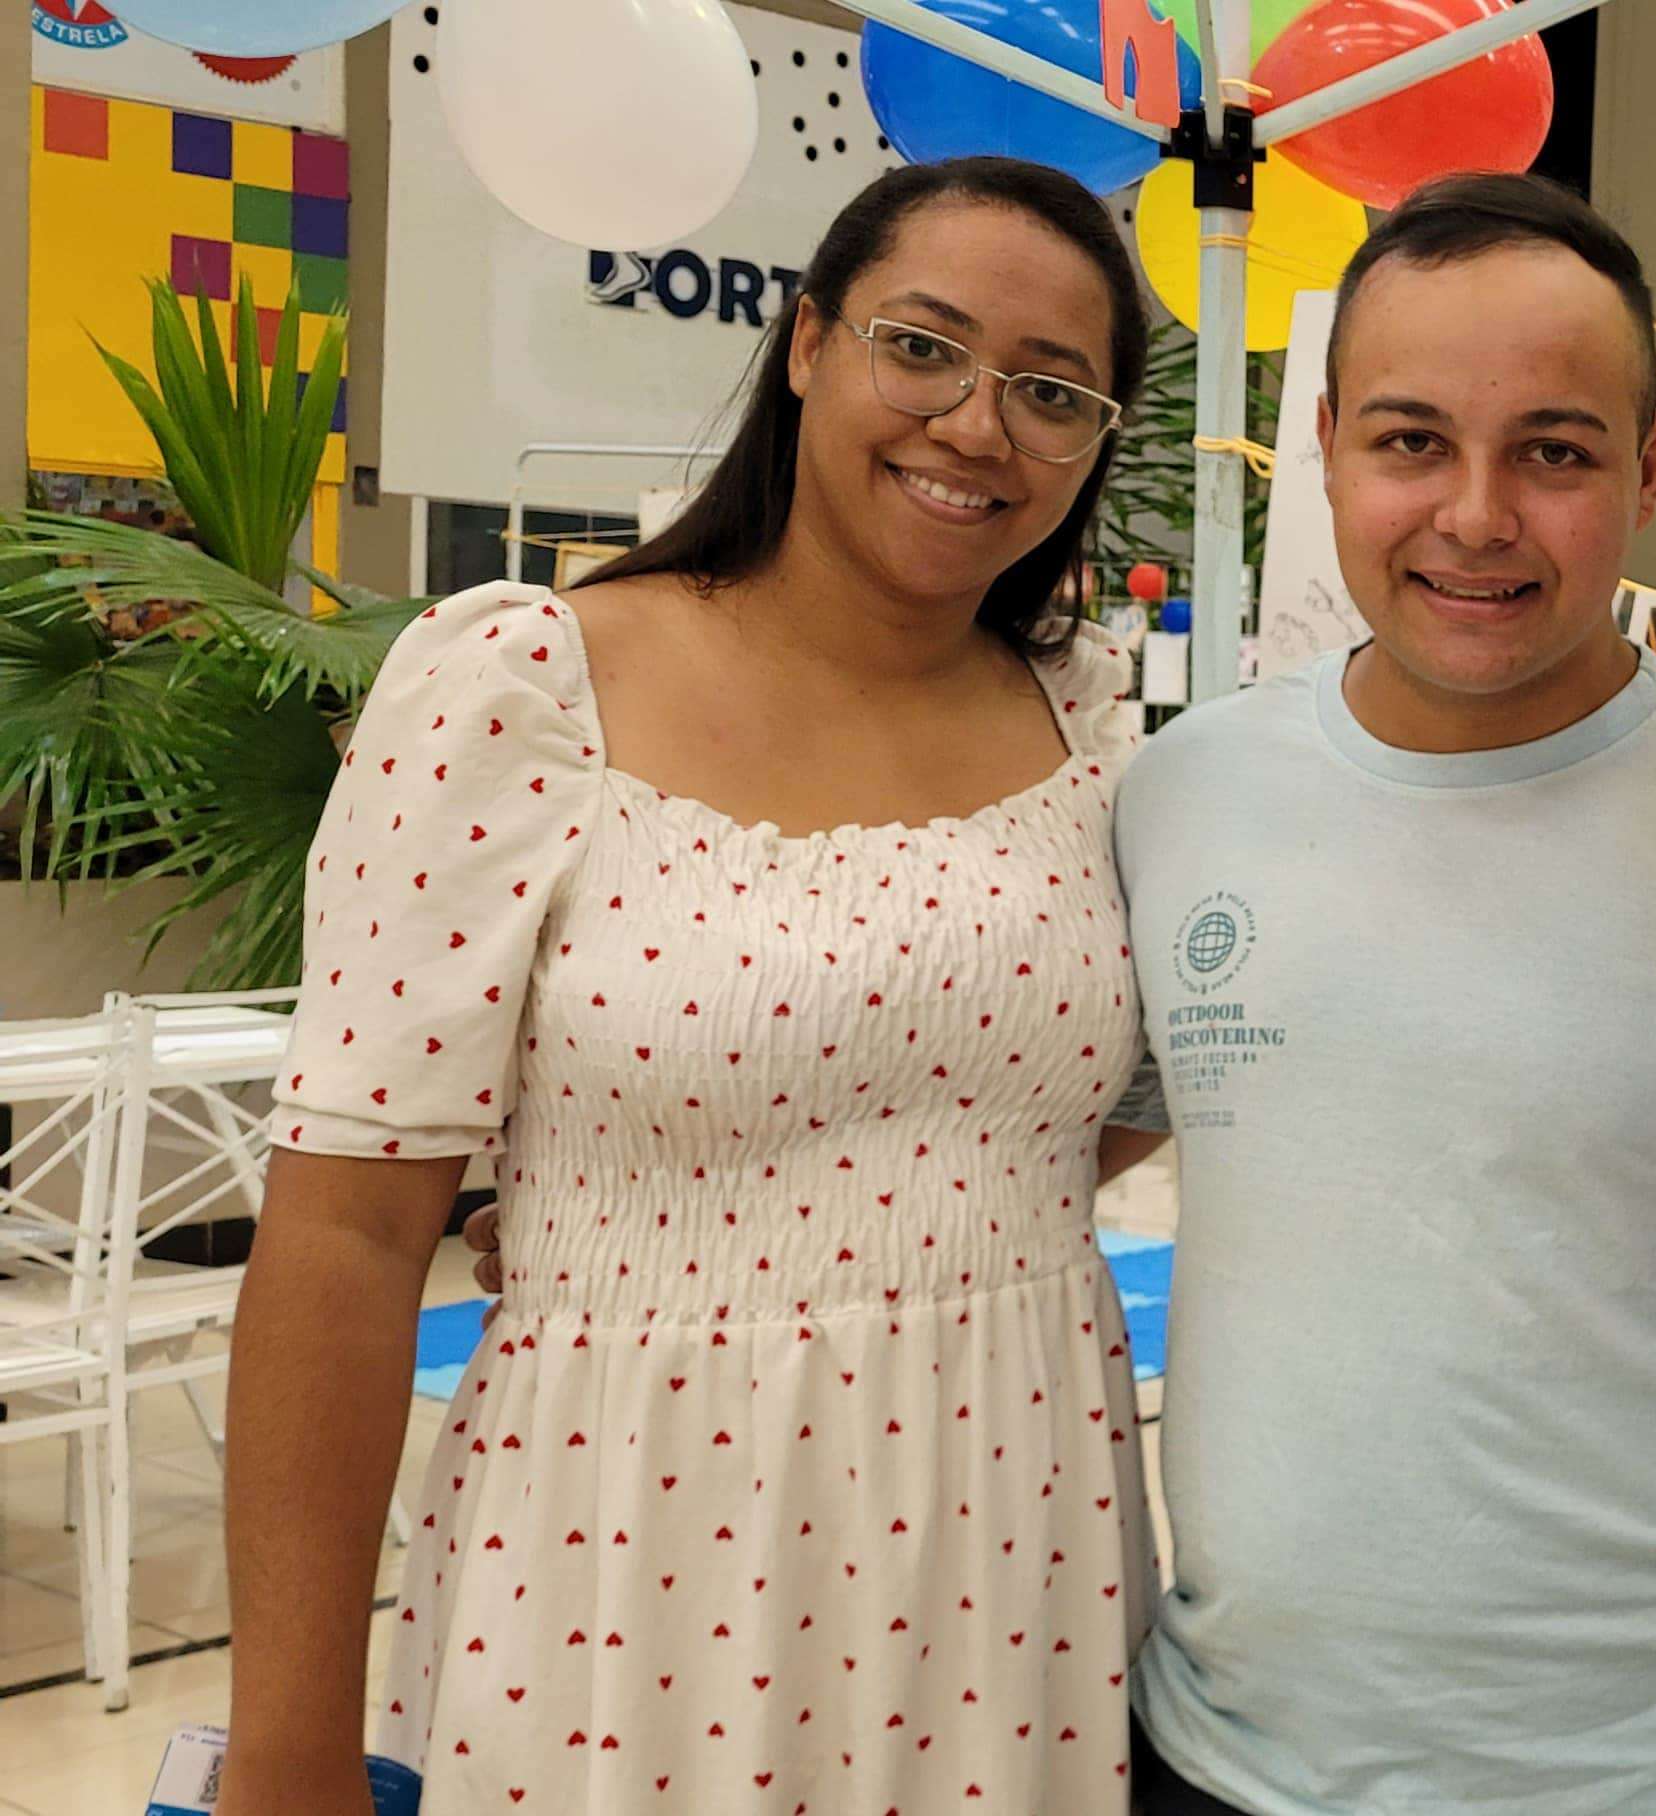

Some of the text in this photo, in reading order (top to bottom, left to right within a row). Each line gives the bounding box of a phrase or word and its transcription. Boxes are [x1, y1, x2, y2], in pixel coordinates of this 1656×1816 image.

[32, 8, 123, 45] ESTRELA
[1168, 1003, 1245, 1026] OUTDOOR
[1169, 1027, 1286, 1051] DISCOVERING
